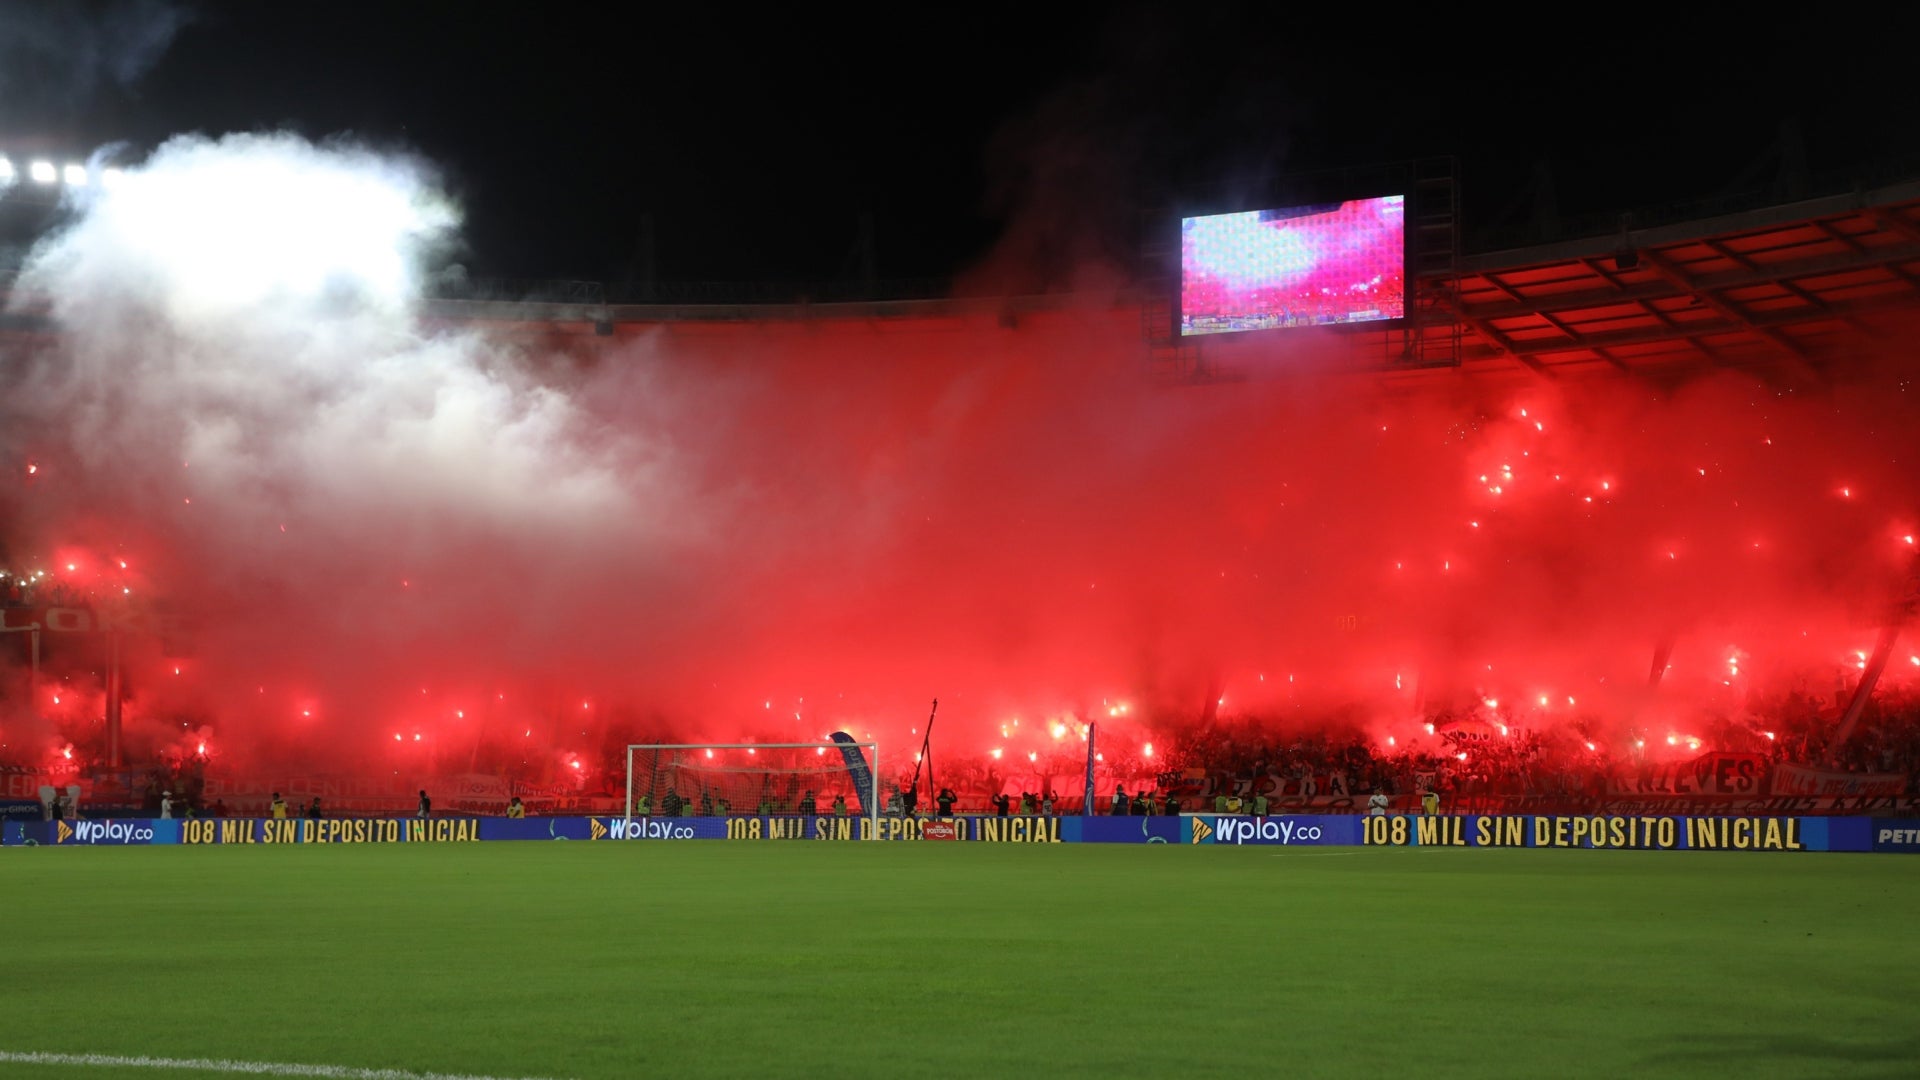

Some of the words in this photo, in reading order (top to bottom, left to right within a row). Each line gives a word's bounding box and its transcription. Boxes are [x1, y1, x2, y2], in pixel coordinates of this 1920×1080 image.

[76, 820, 153, 844] Wplay.co
[182, 820, 214, 844] 108
[222, 820, 257, 844] MIL
[263, 819, 296, 844] SIN
[303, 819, 398, 843] DEPOSITO
[406, 819, 479, 842] INICIAL
[726, 818, 761, 840] 108
[769, 818, 803, 840] MIL
[815, 818, 851, 841] SIN
[976, 817, 1061, 843] INICIAL
[1217, 817, 1322, 845] Wplay.co
[1361, 816, 1407, 845] 108
[1417, 816, 1465, 846] MIL
[1477, 817, 1523, 846] SIN
[1535, 816, 1674, 847] DEPOSITO
[1686, 817, 1801, 849] INICIAL
